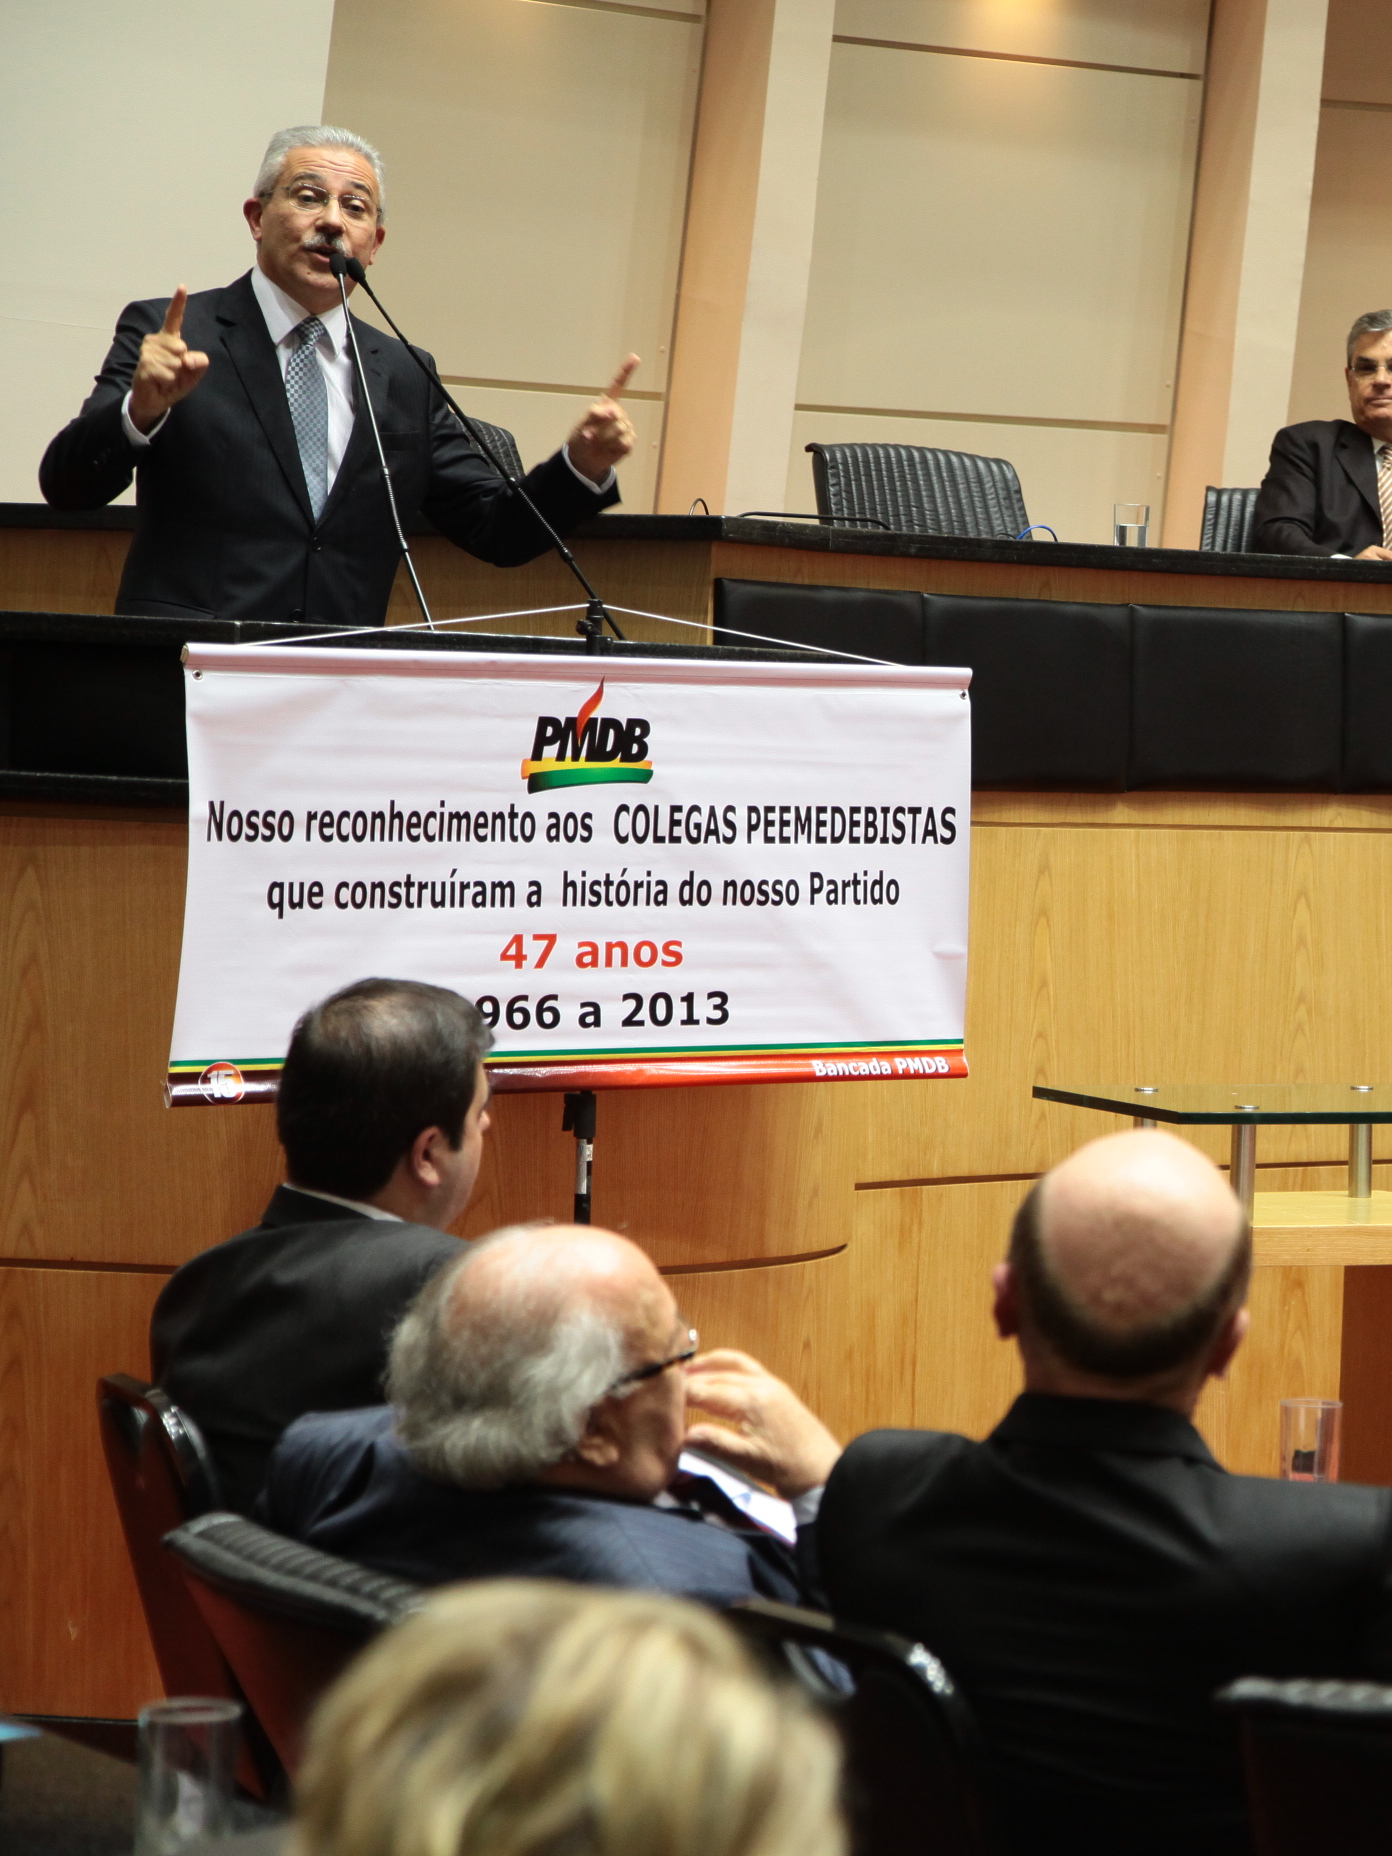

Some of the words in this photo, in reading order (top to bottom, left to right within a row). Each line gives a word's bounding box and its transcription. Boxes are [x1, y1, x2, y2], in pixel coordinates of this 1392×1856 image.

[530, 715, 651, 764] PMDB
[206, 800, 295, 843] Nosso
[305, 799, 536, 843] reconhecimento
[546, 809, 593, 844] aos
[613, 803, 737, 845] COLEGAS
[747, 805, 957, 845] PEEMEDEBISTAS
[266, 880, 324, 920] que
[334, 868, 515, 910] construíram
[526, 879, 542, 909] a
[562, 868, 668, 908] história
[678, 870, 712, 907] do
[722, 879, 800, 907] nosso
[810, 870, 900, 907] Partido
[499, 933, 558, 970] 47
[575, 939, 684, 969] anos
[475, 994, 561, 1031] 966
[578, 1001, 602, 1030] a
[621, 990, 730, 1028] 2013
[206, 1070, 237, 1098] 15
[813, 1056, 892, 1077] Bancada
[894, 1056, 950, 1075] PMDB
